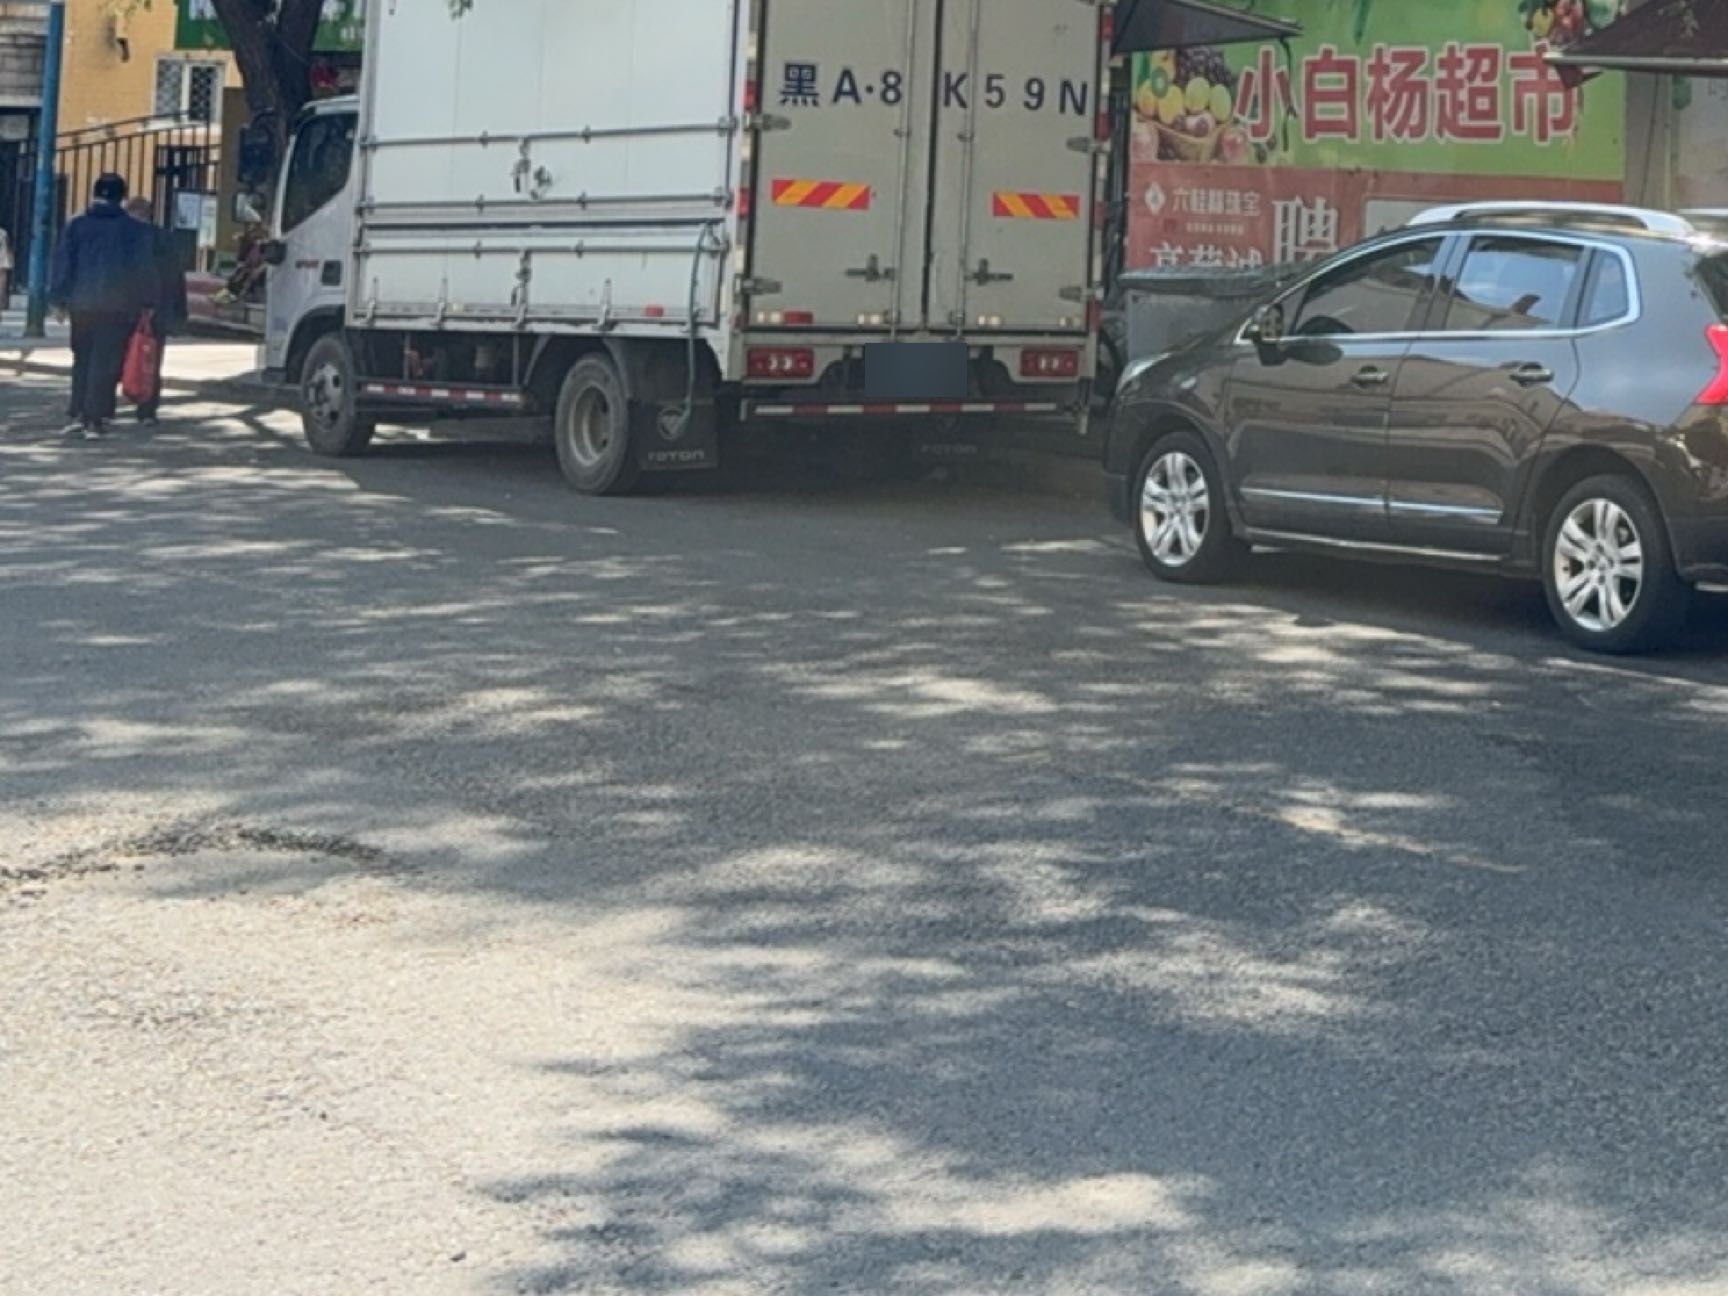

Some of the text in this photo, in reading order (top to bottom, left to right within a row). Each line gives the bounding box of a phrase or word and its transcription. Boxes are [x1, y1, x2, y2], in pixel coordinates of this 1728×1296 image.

[1234, 42, 1580, 144] 小白杨超市
